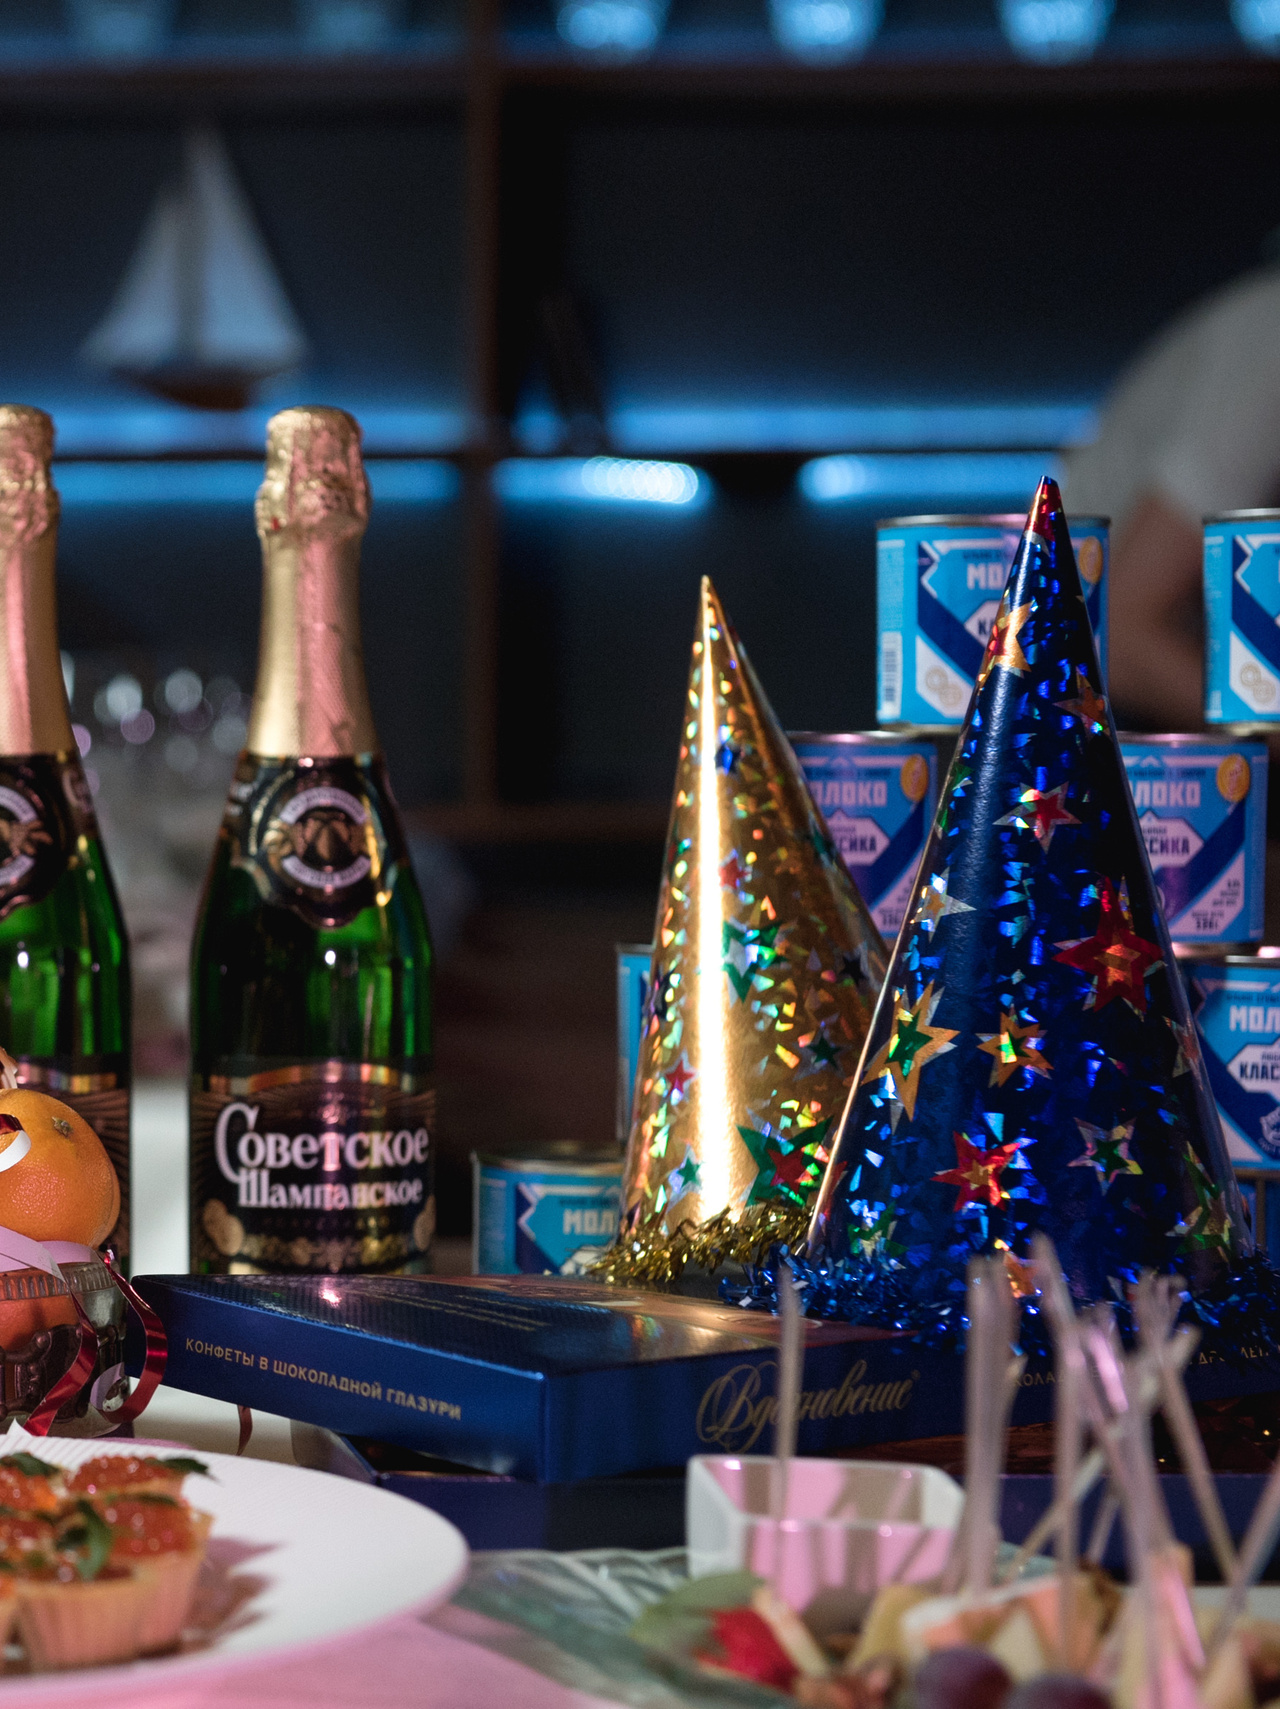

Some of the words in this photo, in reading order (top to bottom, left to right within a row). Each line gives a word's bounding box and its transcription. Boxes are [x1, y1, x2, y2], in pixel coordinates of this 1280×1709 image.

[809, 780, 887, 807] ОЛОКО
[1129, 780, 1200, 808] ЛОКО
[214, 1102, 429, 1184] Советское
[238, 1167, 423, 1210] Шампанское
[562, 1208, 615, 1236] МОЛ
[185, 1337, 254, 1368] КОНФЕТЫ
[259, 1356, 269, 1371] В
[273, 1360, 382, 1400] ШОКОЛАДНОЙ
[386, 1388, 461, 1420] ГЛАЗУРИ
